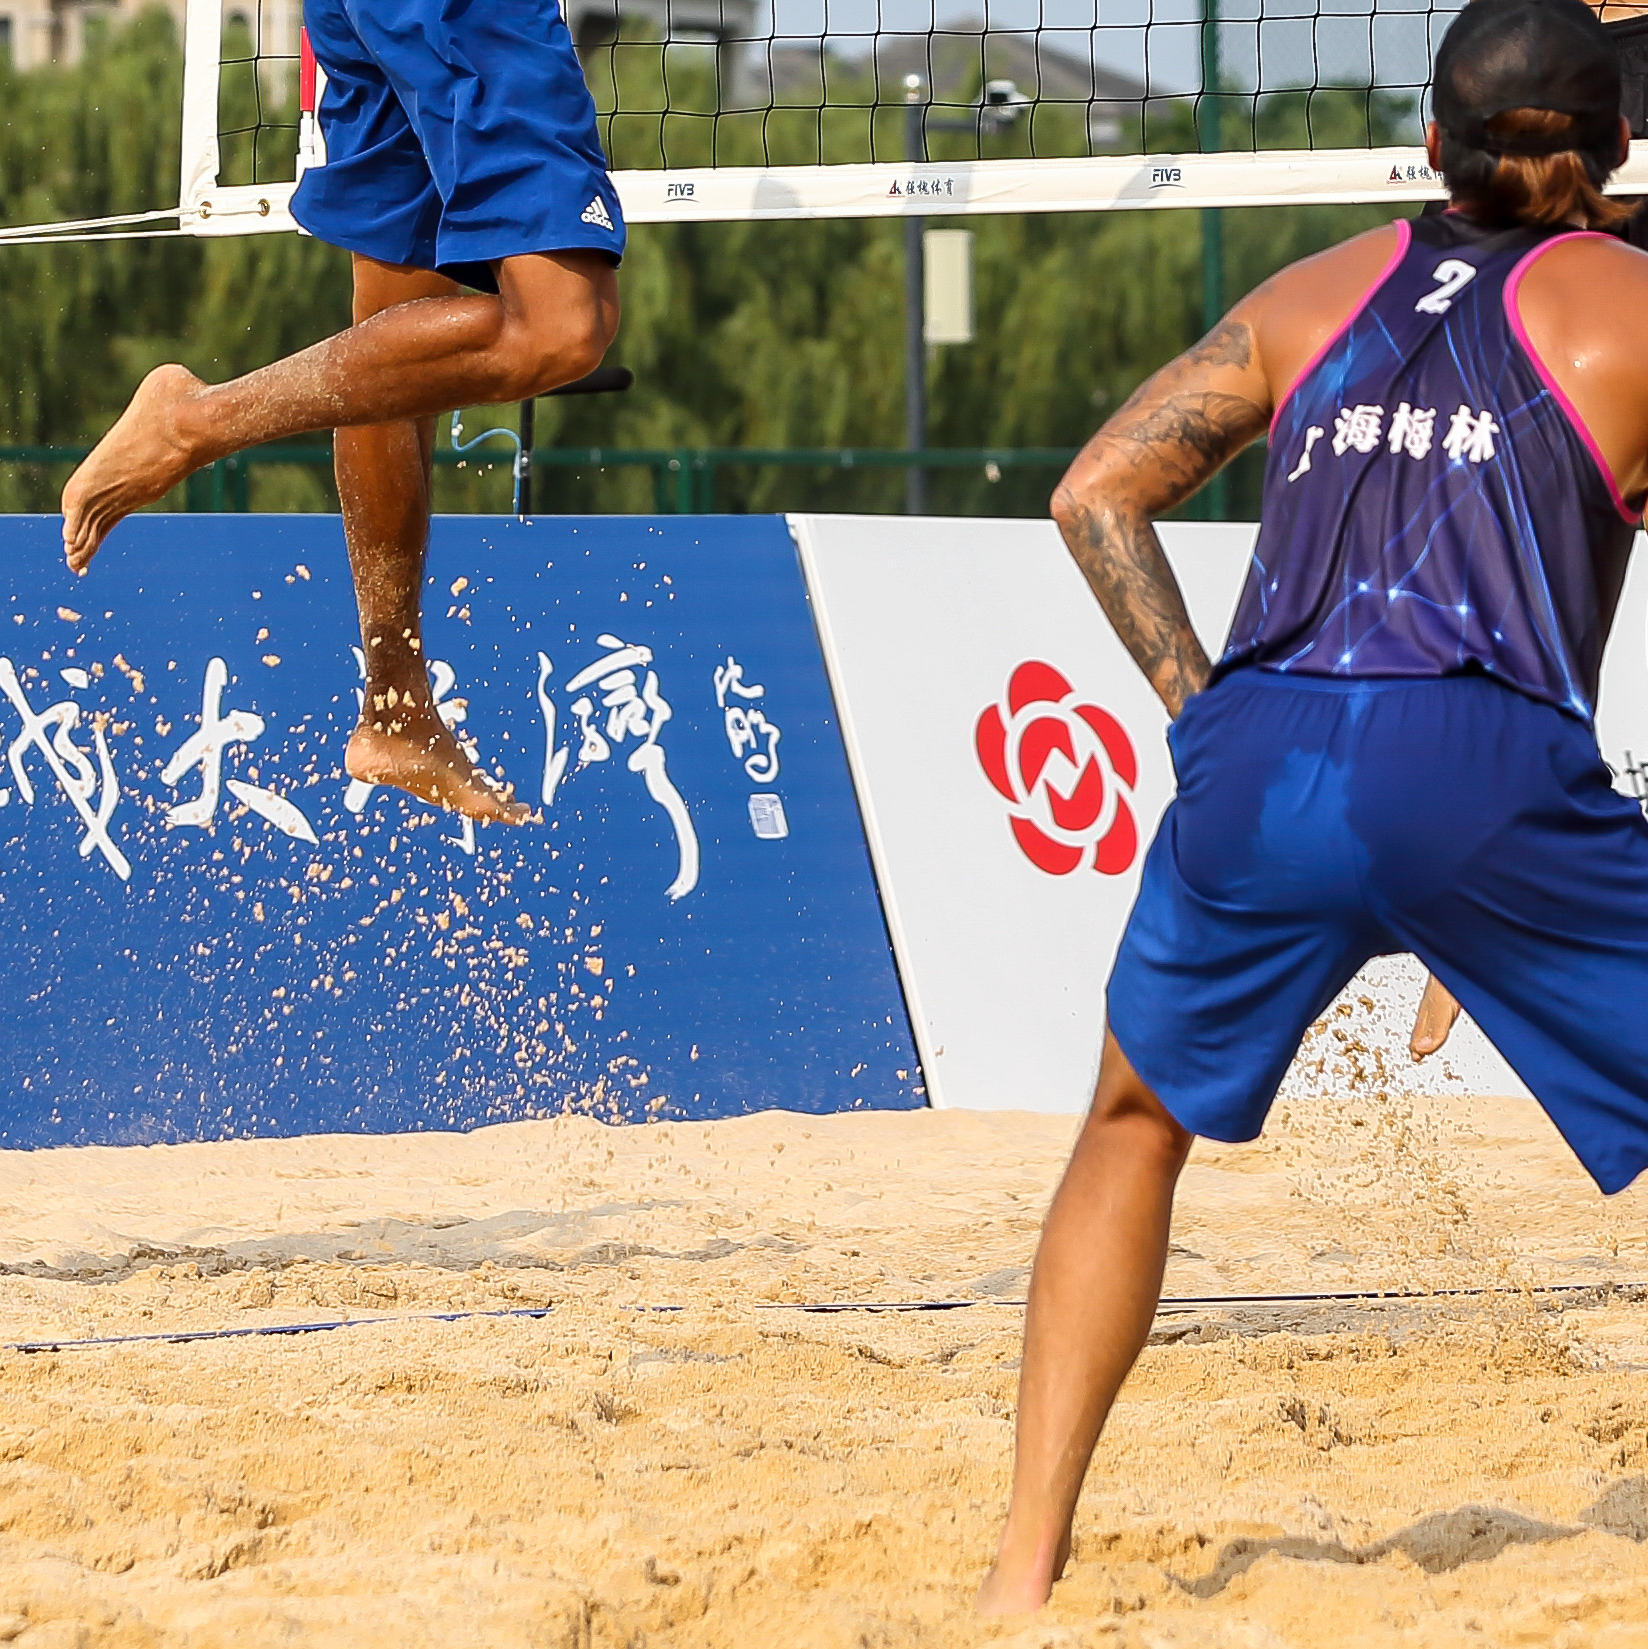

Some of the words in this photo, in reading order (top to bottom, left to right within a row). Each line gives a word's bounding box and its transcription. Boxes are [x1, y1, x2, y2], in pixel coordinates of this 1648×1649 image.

[1152, 168, 1182, 182] FIVB
[668, 183, 695, 197] FIVB
[1415, 260, 1477, 314] 2
